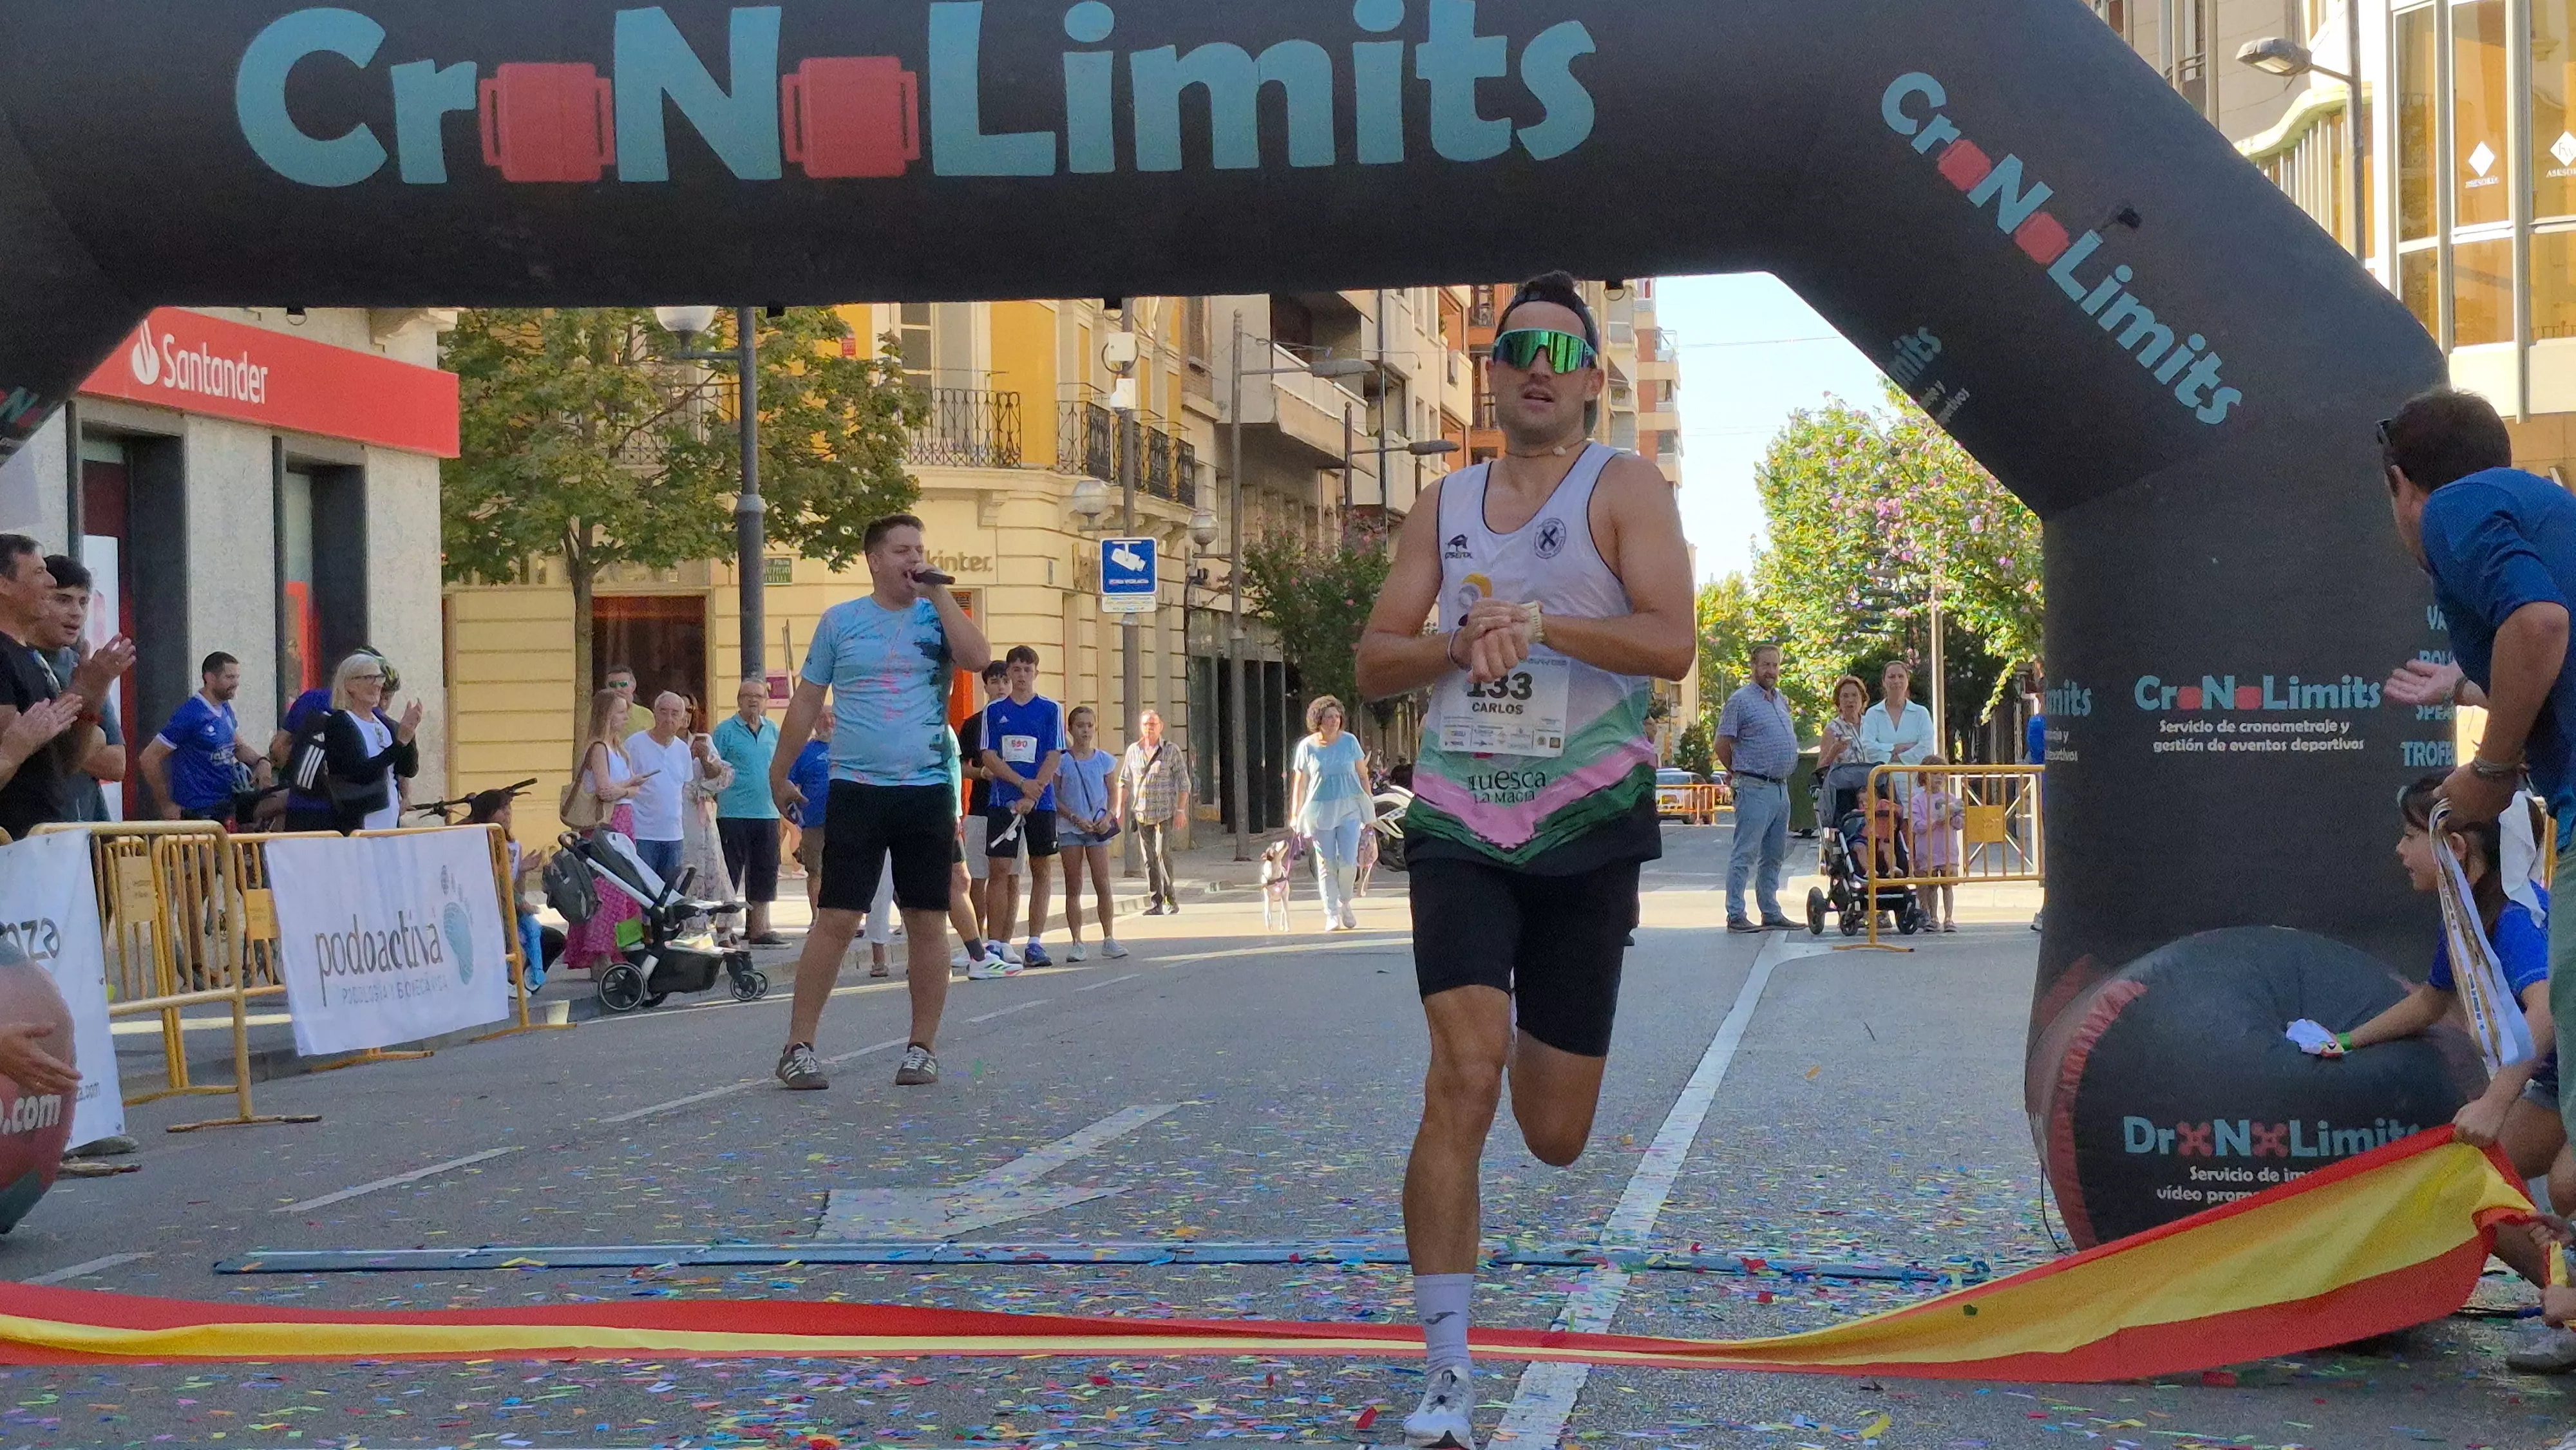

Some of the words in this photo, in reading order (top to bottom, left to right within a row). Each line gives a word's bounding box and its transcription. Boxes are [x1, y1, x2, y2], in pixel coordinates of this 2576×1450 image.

[163, 334, 269, 404] Santander
[1471, 701, 1524, 715] CARLOS
[2159, 719, 2213, 733] Servicio
[2217, 719, 2236, 733] de
[2239, 719, 2338, 734] cronometraje
[2340, 721, 2351, 734] y
[2153, 738, 2204, 753] gestión
[2207, 738, 2226, 752] de
[2229, 739, 2287, 752] eventos
[2290, 737, 2365, 753] deportivos
[314, 910, 444, 1008] podoactiva
[0, 1093, 62, 1136] .com
[2190, 1165, 2254, 1182] Servicio
[2257, 1167, 2280, 1182] de
[2156, 1184, 2202, 1201] vídeo
